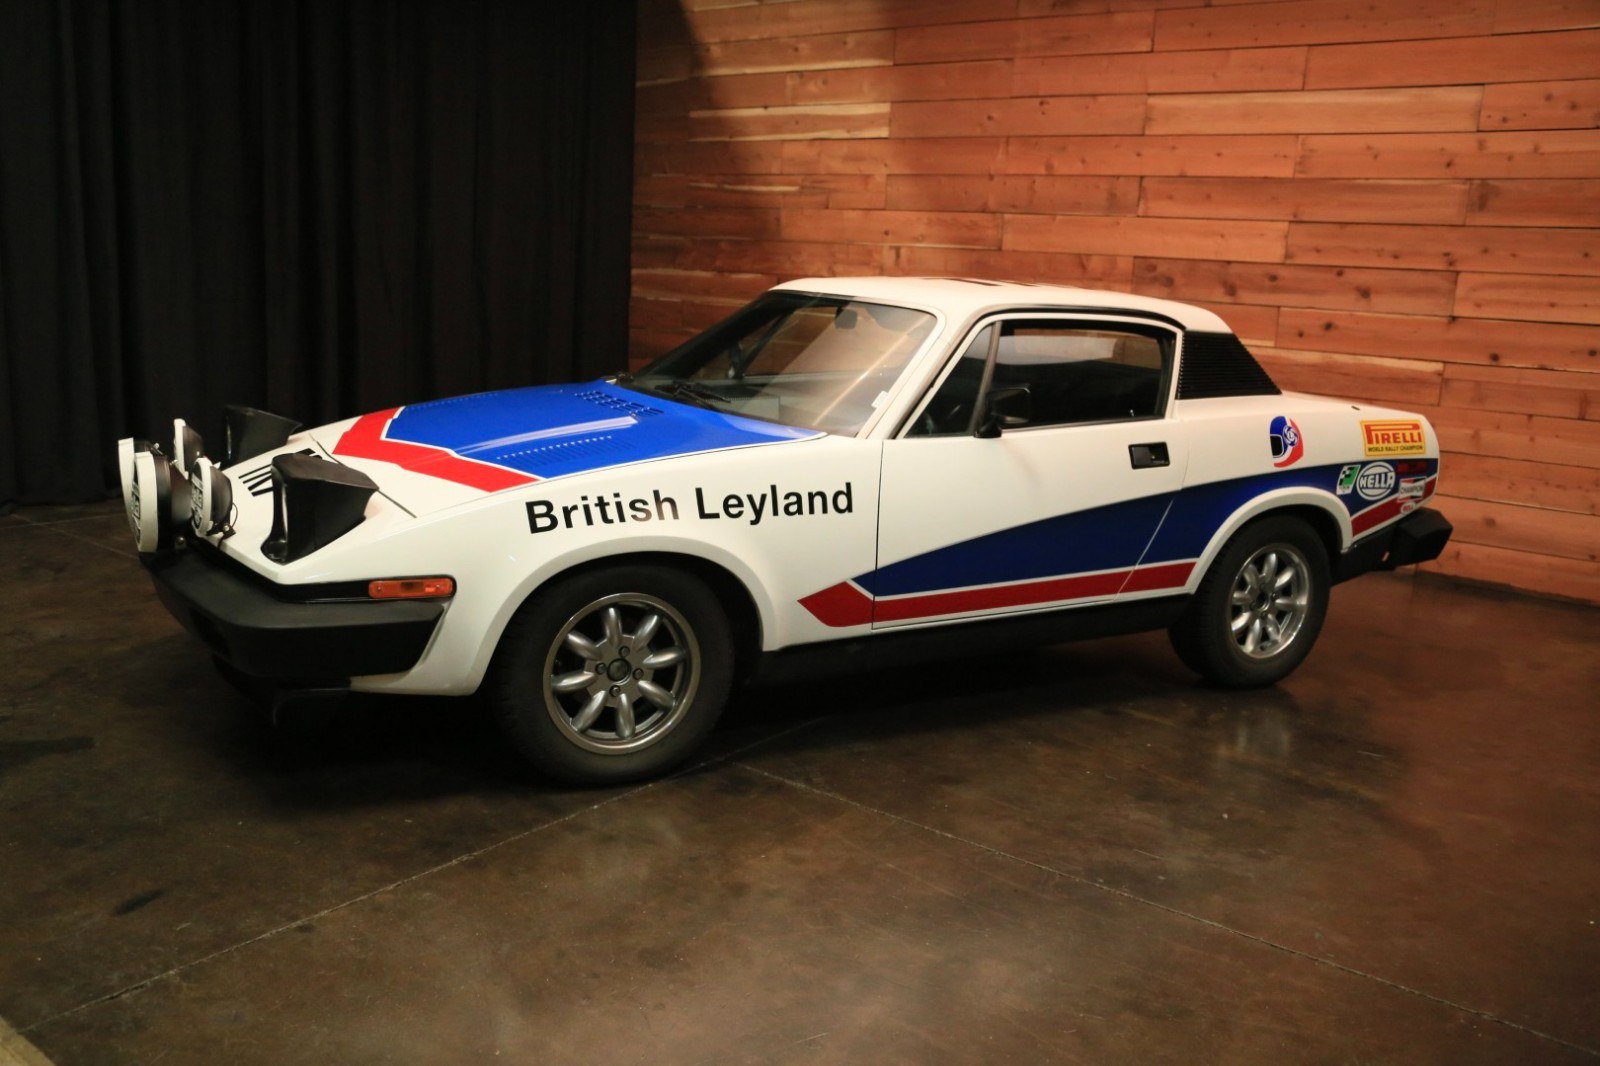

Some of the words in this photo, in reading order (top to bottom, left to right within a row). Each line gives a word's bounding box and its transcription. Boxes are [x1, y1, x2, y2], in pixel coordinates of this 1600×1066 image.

[1364, 423, 1422, 444] PIRELLI
[1360, 471, 1396, 489] HELLA
[1400, 485, 1423, 495] CHAMPION
[525, 489, 680, 534] British
[695, 482, 854, 526] Leyland
